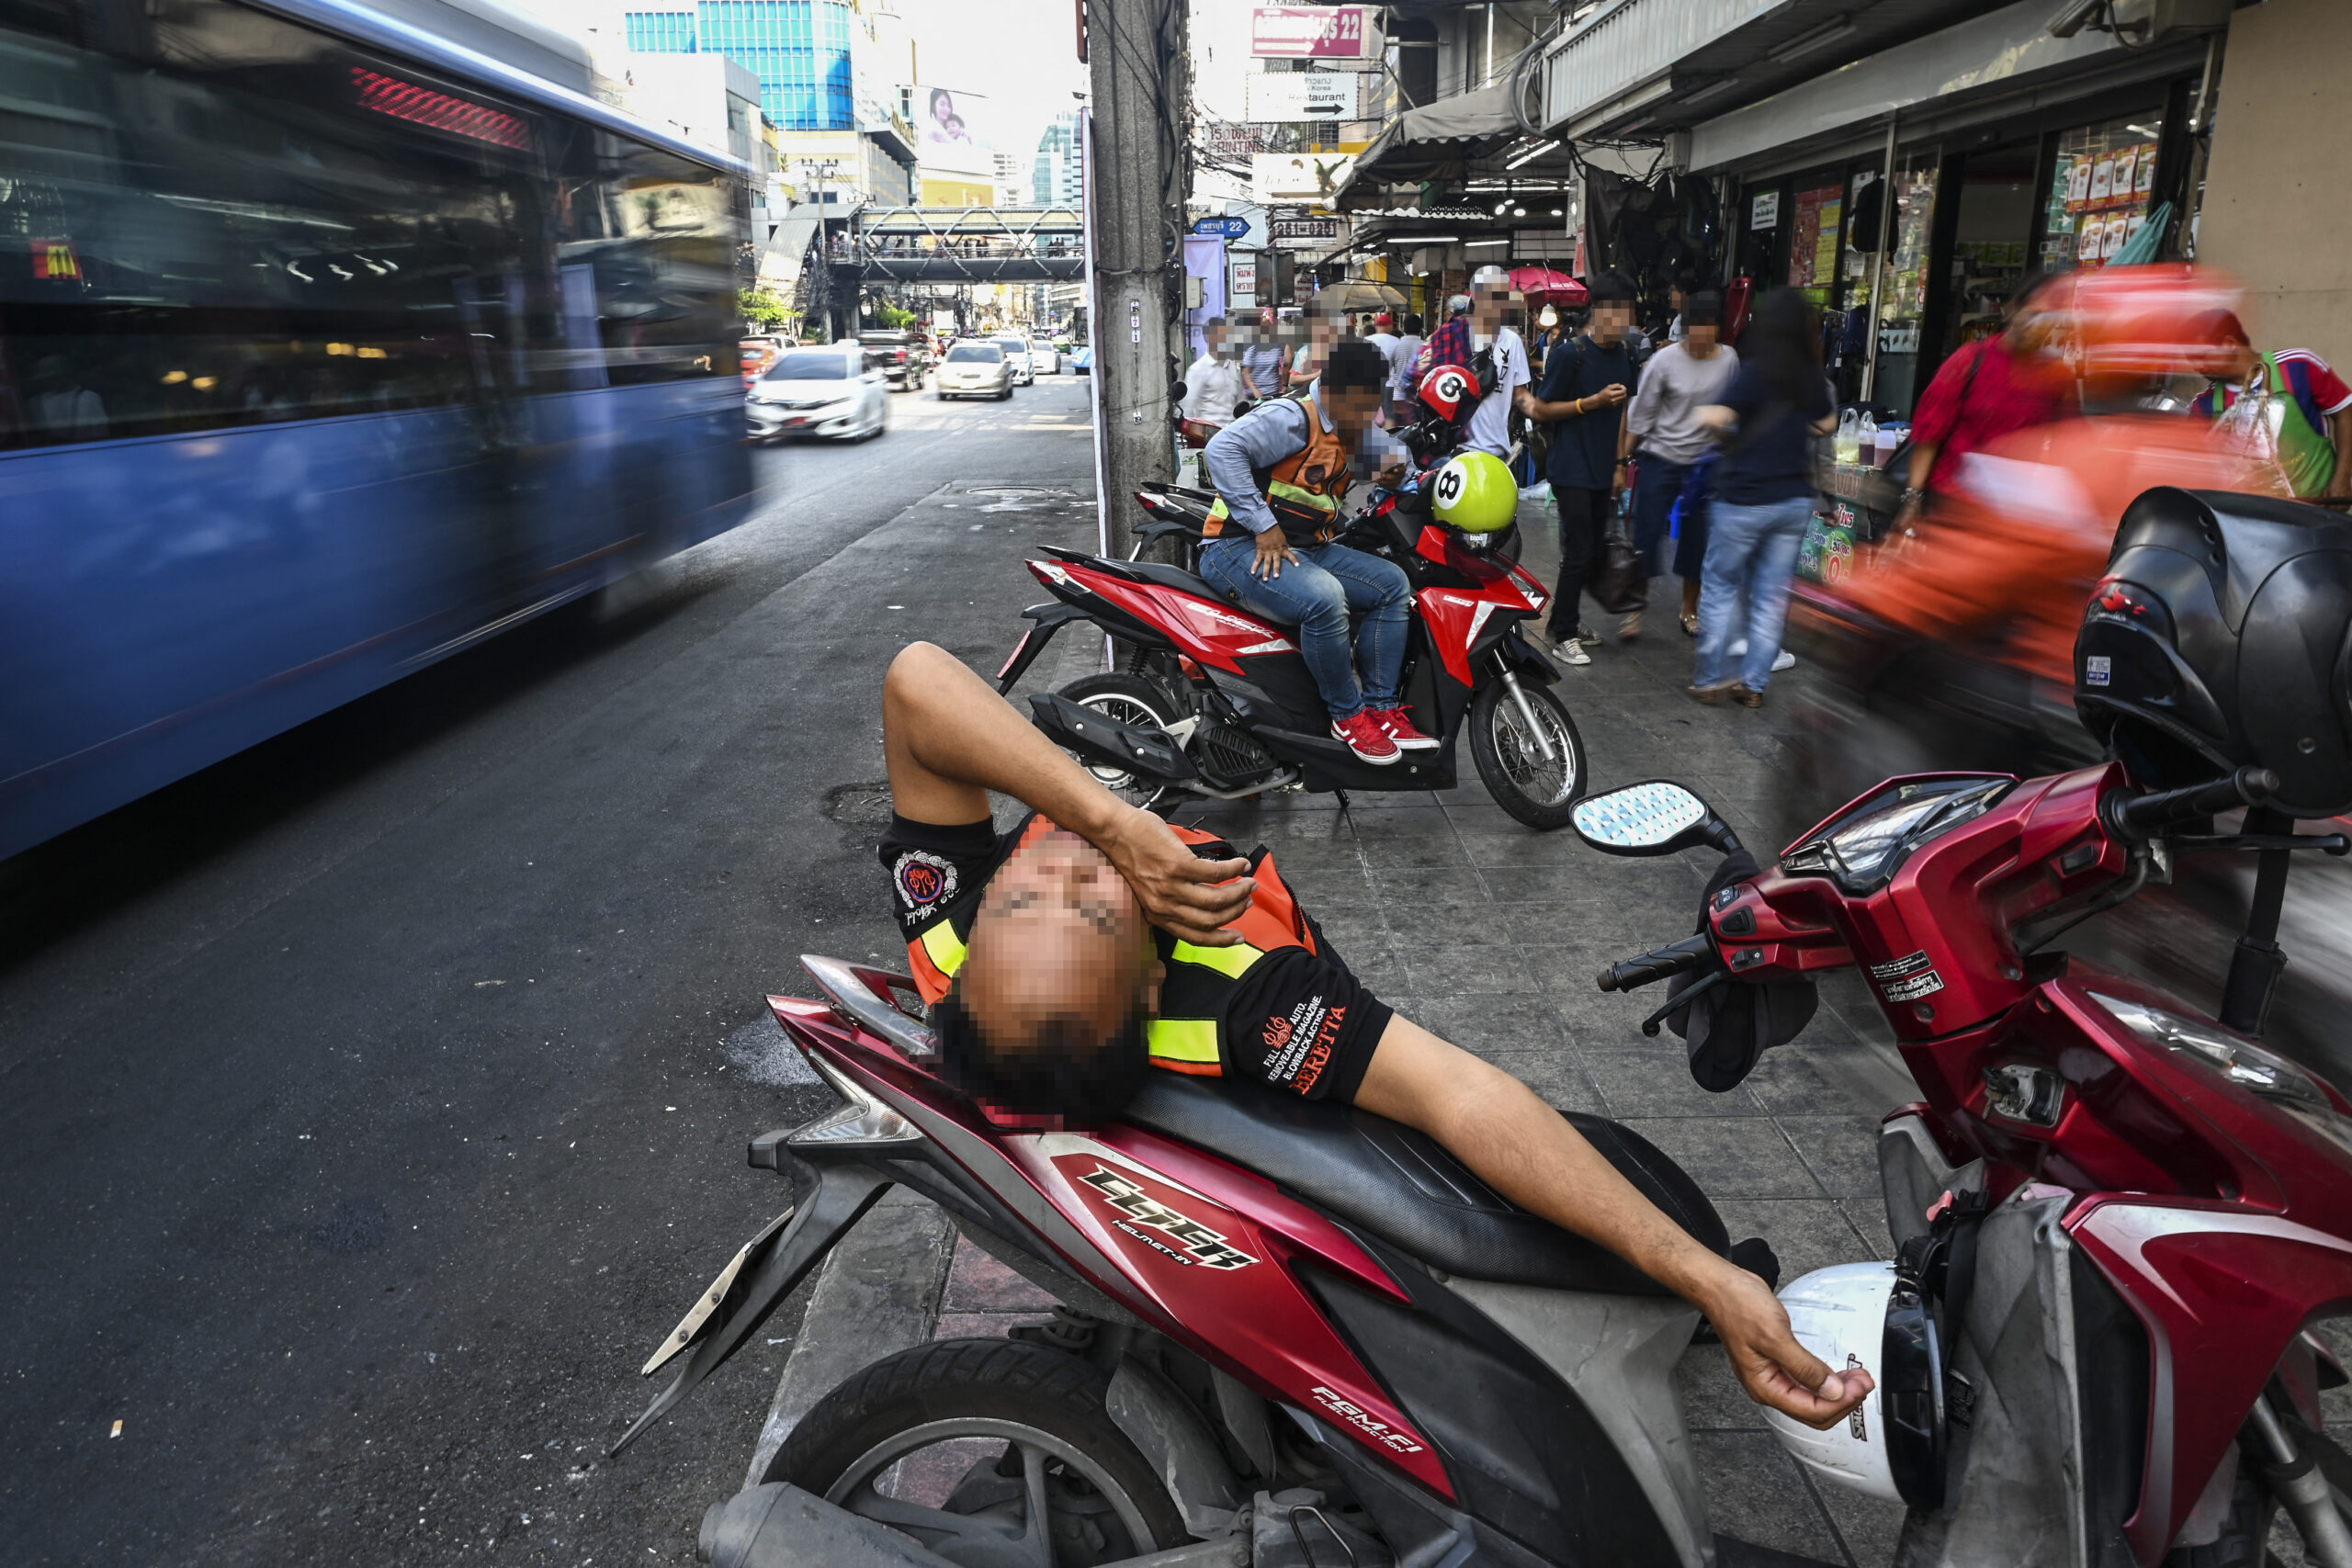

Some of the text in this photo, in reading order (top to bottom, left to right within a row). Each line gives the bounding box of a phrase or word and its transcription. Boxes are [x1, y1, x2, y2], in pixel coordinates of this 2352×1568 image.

[1340, 14, 1360, 39] 22
[1228, 221, 1242, 231] 22
[1133, 319, 1138, 327] 7
[1441, 377, 1463, 398] 8
[1438, 470, 1461, 501] 8
[1263, 1049, 1281, 1067] FULL
[1283, 1008, 1327, 1081] BLOWBACK ACTION
[1288, 1006, 1347, 1096] BERETTA
[1111, 1219, 1194, 1267] HELMET-IN
[1313, 1395, 1407, 1454] FUEL INJECTION
